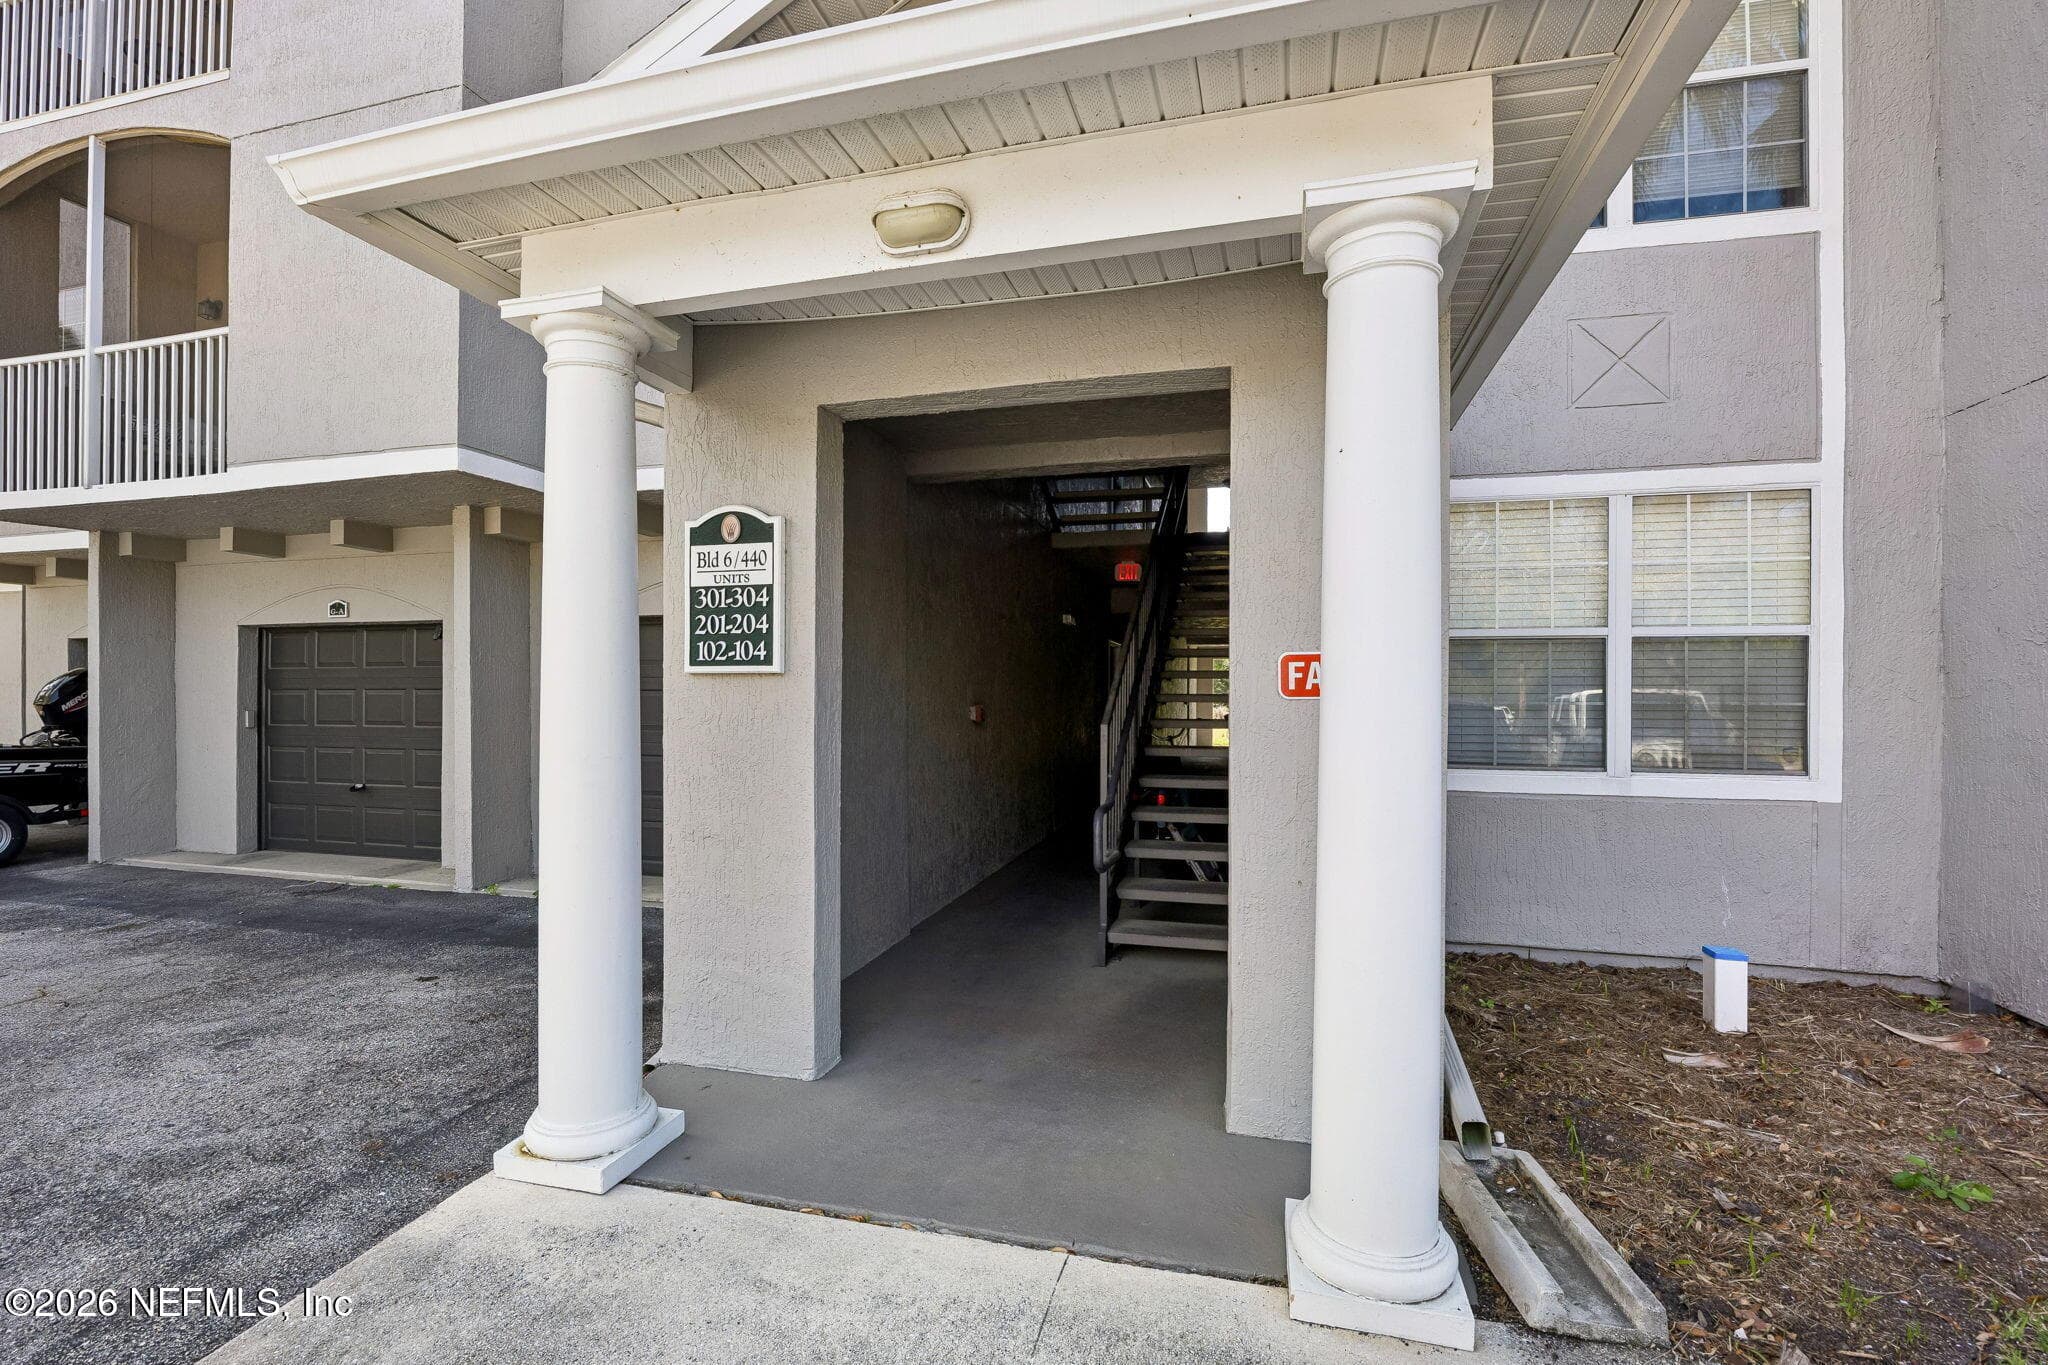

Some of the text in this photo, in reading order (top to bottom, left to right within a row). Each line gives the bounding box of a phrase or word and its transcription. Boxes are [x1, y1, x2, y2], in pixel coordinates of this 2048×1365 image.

[697, 552, 719, 569] Bld
[713, 573, 750, 584] UNITS
[1119, 563, 1140, 580] EXIT
[694, 586, 770, 609] 301-304
[694, 613, 770, 635] 201-204
[696, 640, 767, 661] 102-104
